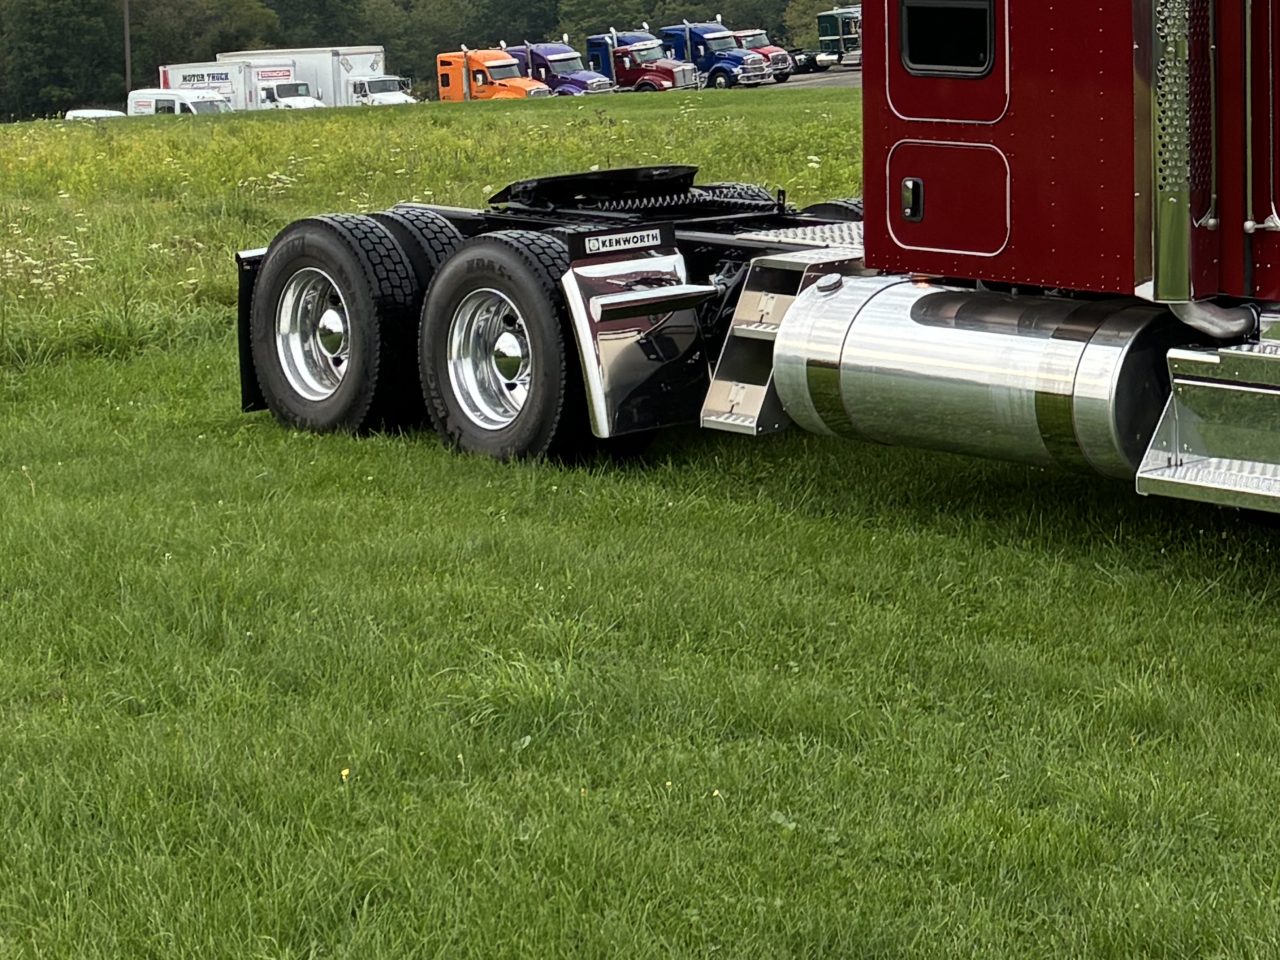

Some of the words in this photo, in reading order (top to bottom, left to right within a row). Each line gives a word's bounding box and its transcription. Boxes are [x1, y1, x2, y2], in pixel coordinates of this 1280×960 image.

[182, 73, 205, 82] MOTOR
[206, 72, 229, 81] TRUCK
[601, 233, 658, 248] KENWORTH
